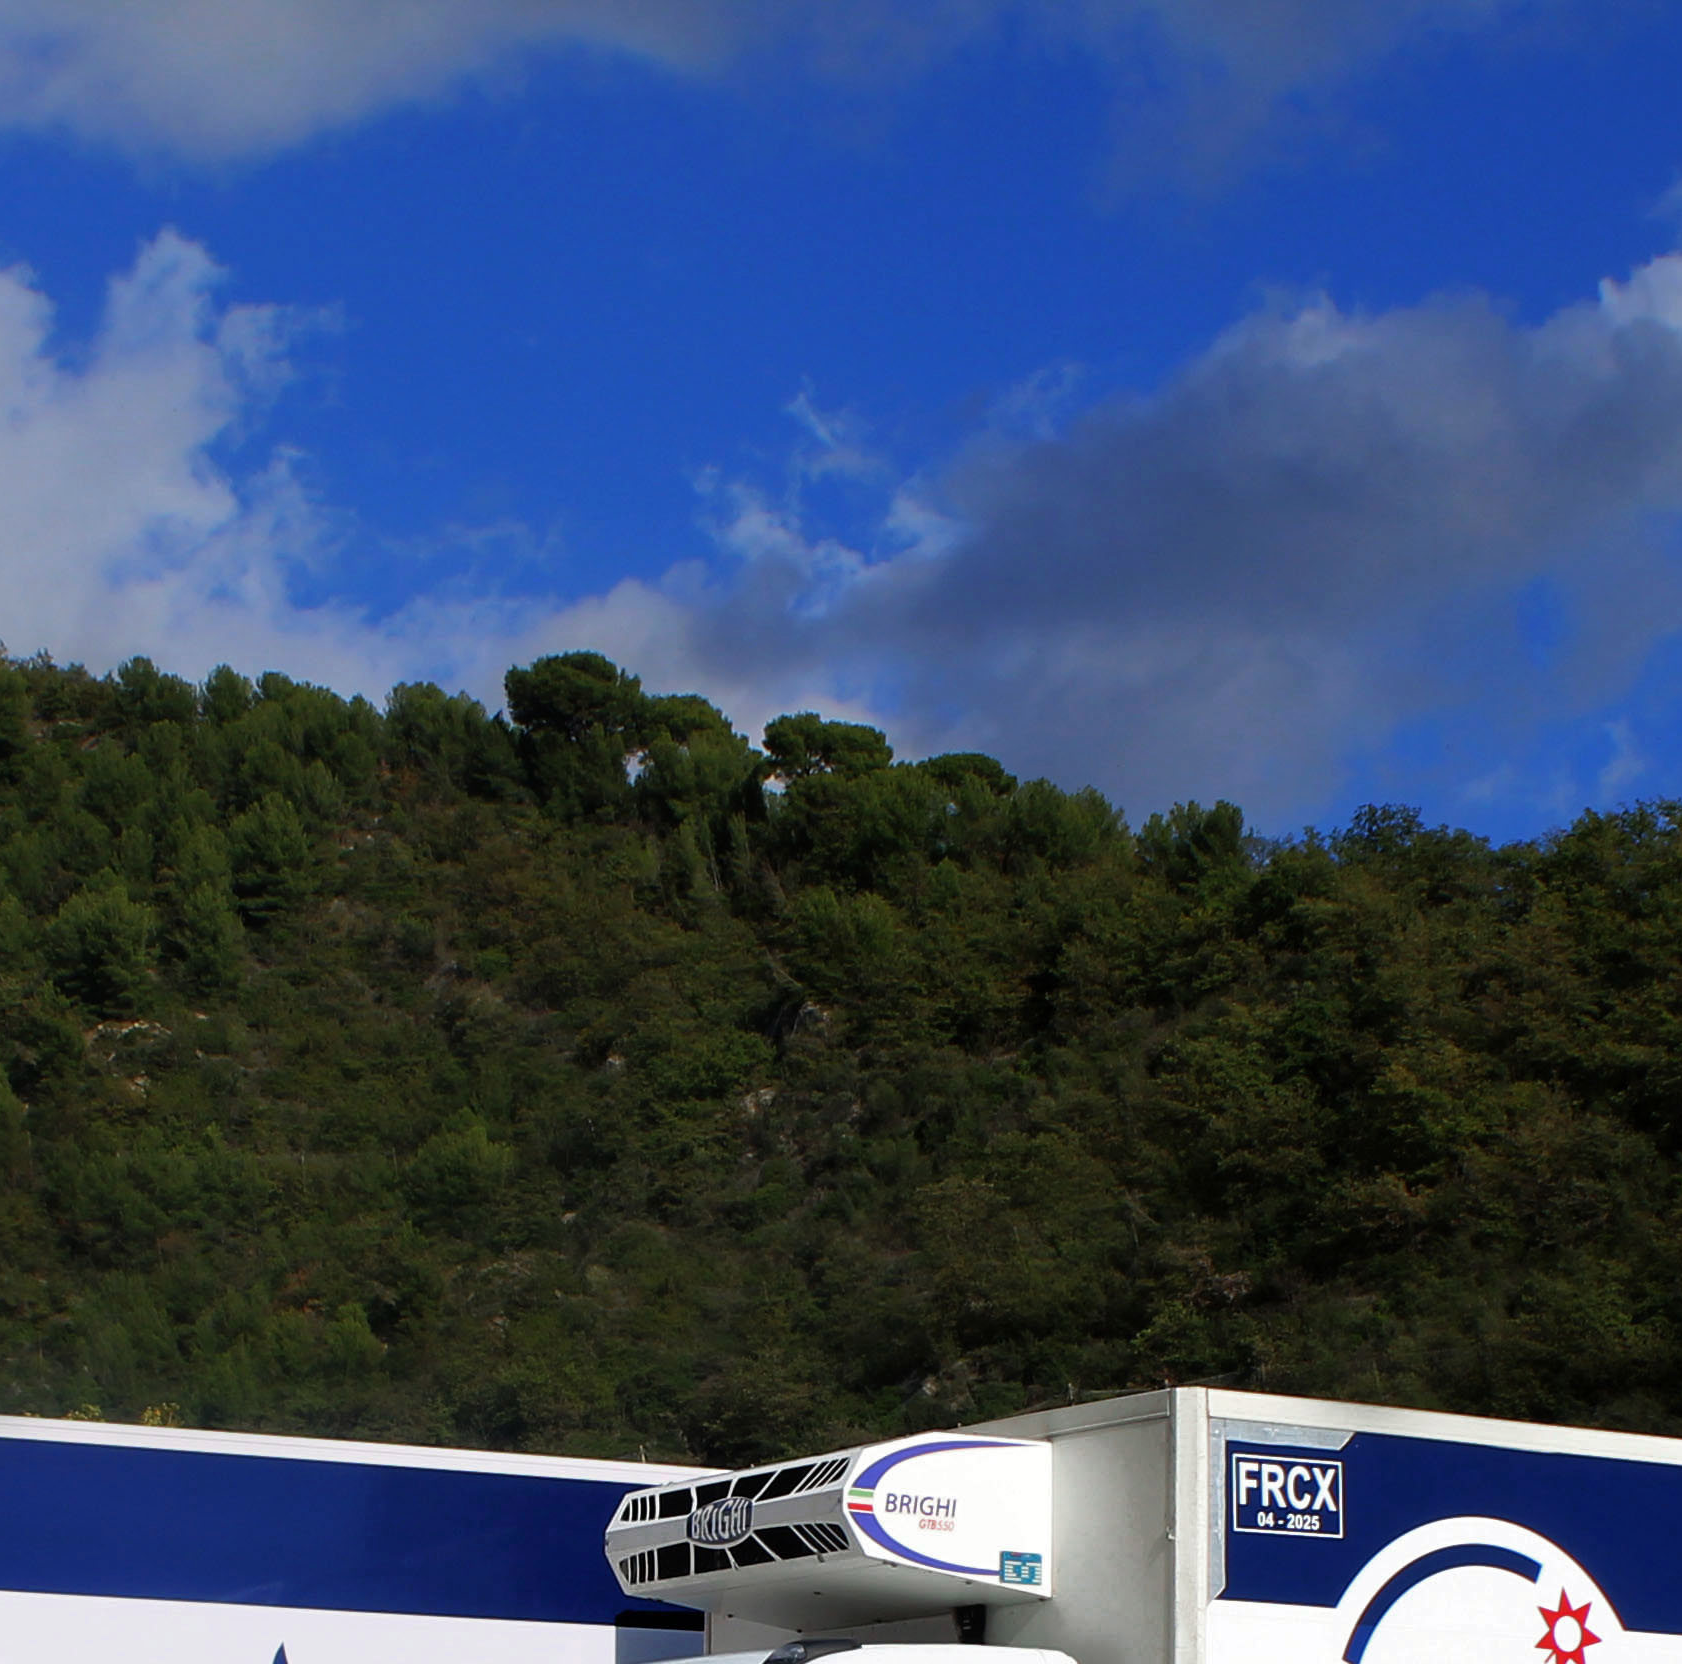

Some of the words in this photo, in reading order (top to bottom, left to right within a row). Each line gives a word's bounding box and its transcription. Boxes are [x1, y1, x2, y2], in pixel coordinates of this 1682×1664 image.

[1238, 1461, 1338, 1512] FRCX
[691, 1497, 751, 1542] BRIGHI
[884, 1492, 957, 1519] BRIGHI
[1257, 1512, 1275, 1528] 04
[1287, 1513, 1321, 1532] 2025
